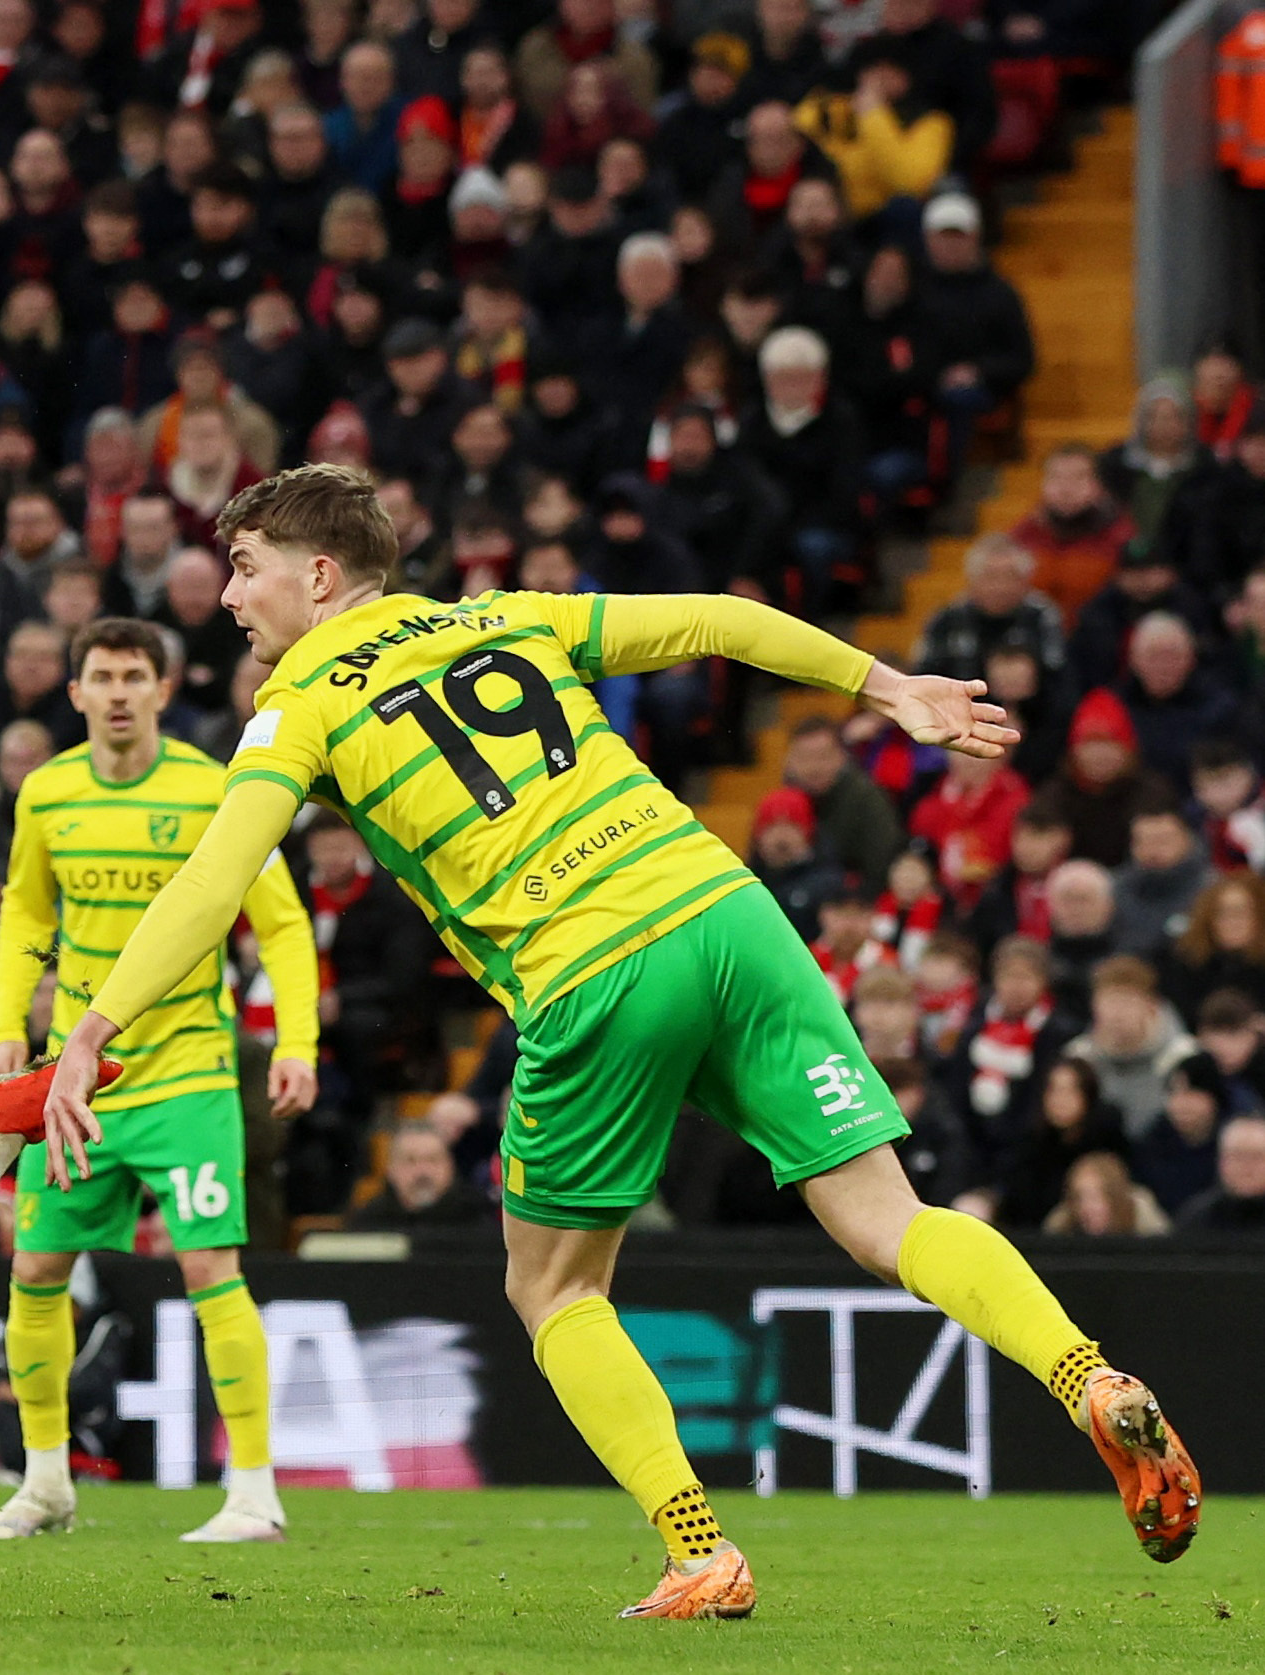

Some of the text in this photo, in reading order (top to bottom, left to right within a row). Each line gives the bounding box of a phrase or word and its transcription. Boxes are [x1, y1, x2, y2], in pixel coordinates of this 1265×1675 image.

[369, 649, 577, 822] 19
[550, 804, 659, 880] SEKURA.id
[67, 868, 162, 892] LOTUS
[830, 1122, 853, 1137] DATA
[168, 1161, 230, 1222] 16
